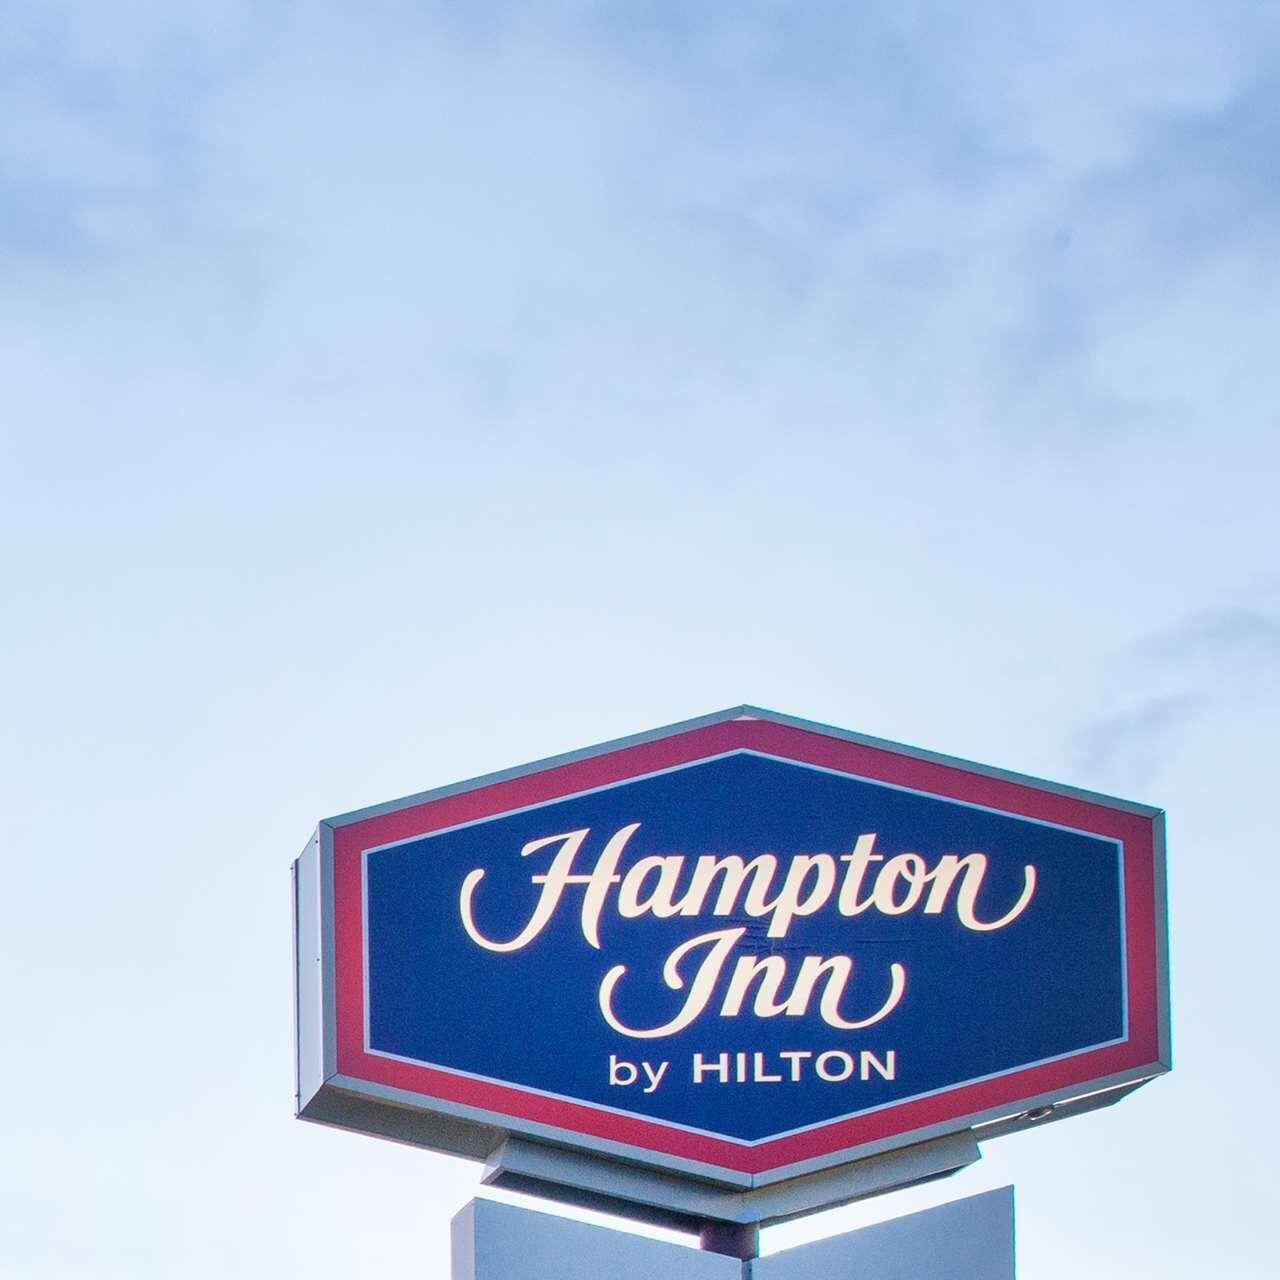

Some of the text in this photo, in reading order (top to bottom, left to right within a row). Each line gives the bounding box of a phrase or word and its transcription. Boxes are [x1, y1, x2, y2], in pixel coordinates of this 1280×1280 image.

[460, 823, 1036, 953] Hampton
[599, 928, 905, 1039] Inn
[609, 1050, 895, 1093] by HILTON
